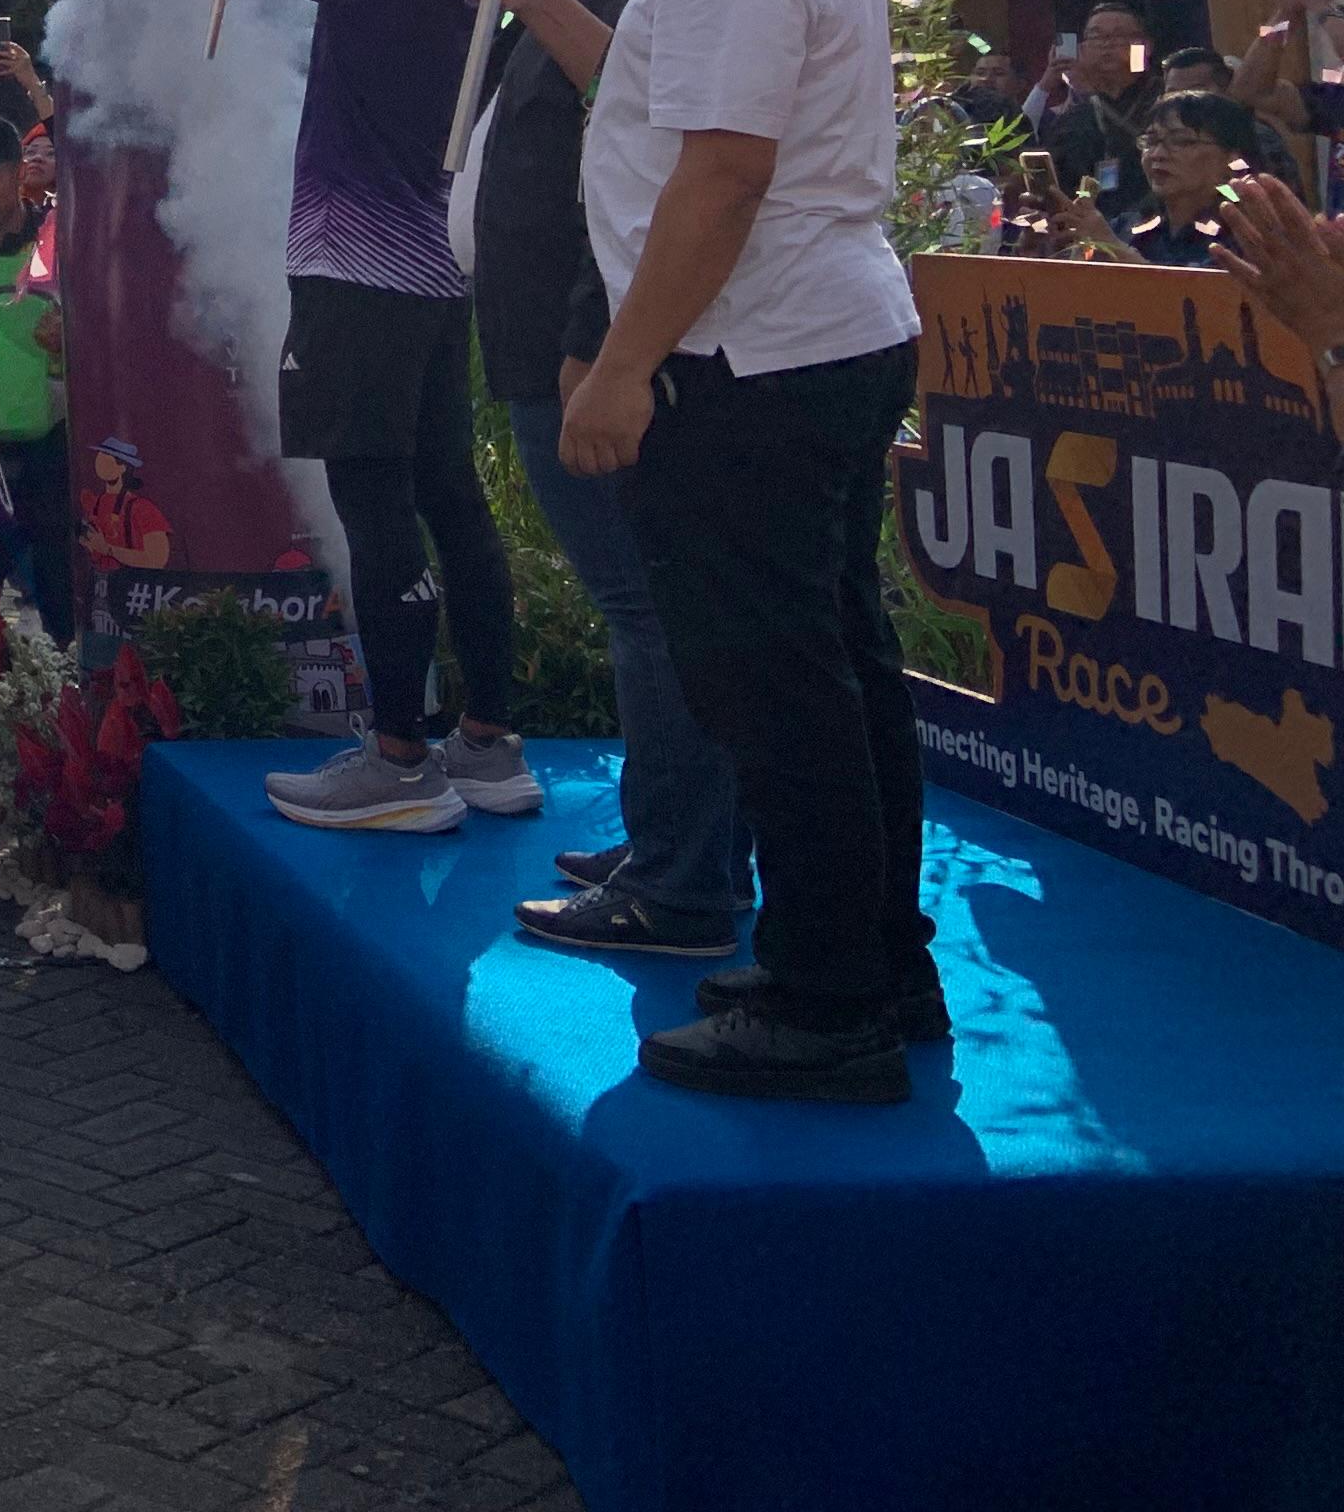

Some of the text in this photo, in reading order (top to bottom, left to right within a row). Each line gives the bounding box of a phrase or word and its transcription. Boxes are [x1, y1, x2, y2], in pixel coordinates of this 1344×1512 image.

[915, 424, 1344, 669] JASIRA
[1016, 613, 1182, 736] Race
[1023, 747, 1147, 835] Heritage,
[1154, 795, 1259, 883] Racing
